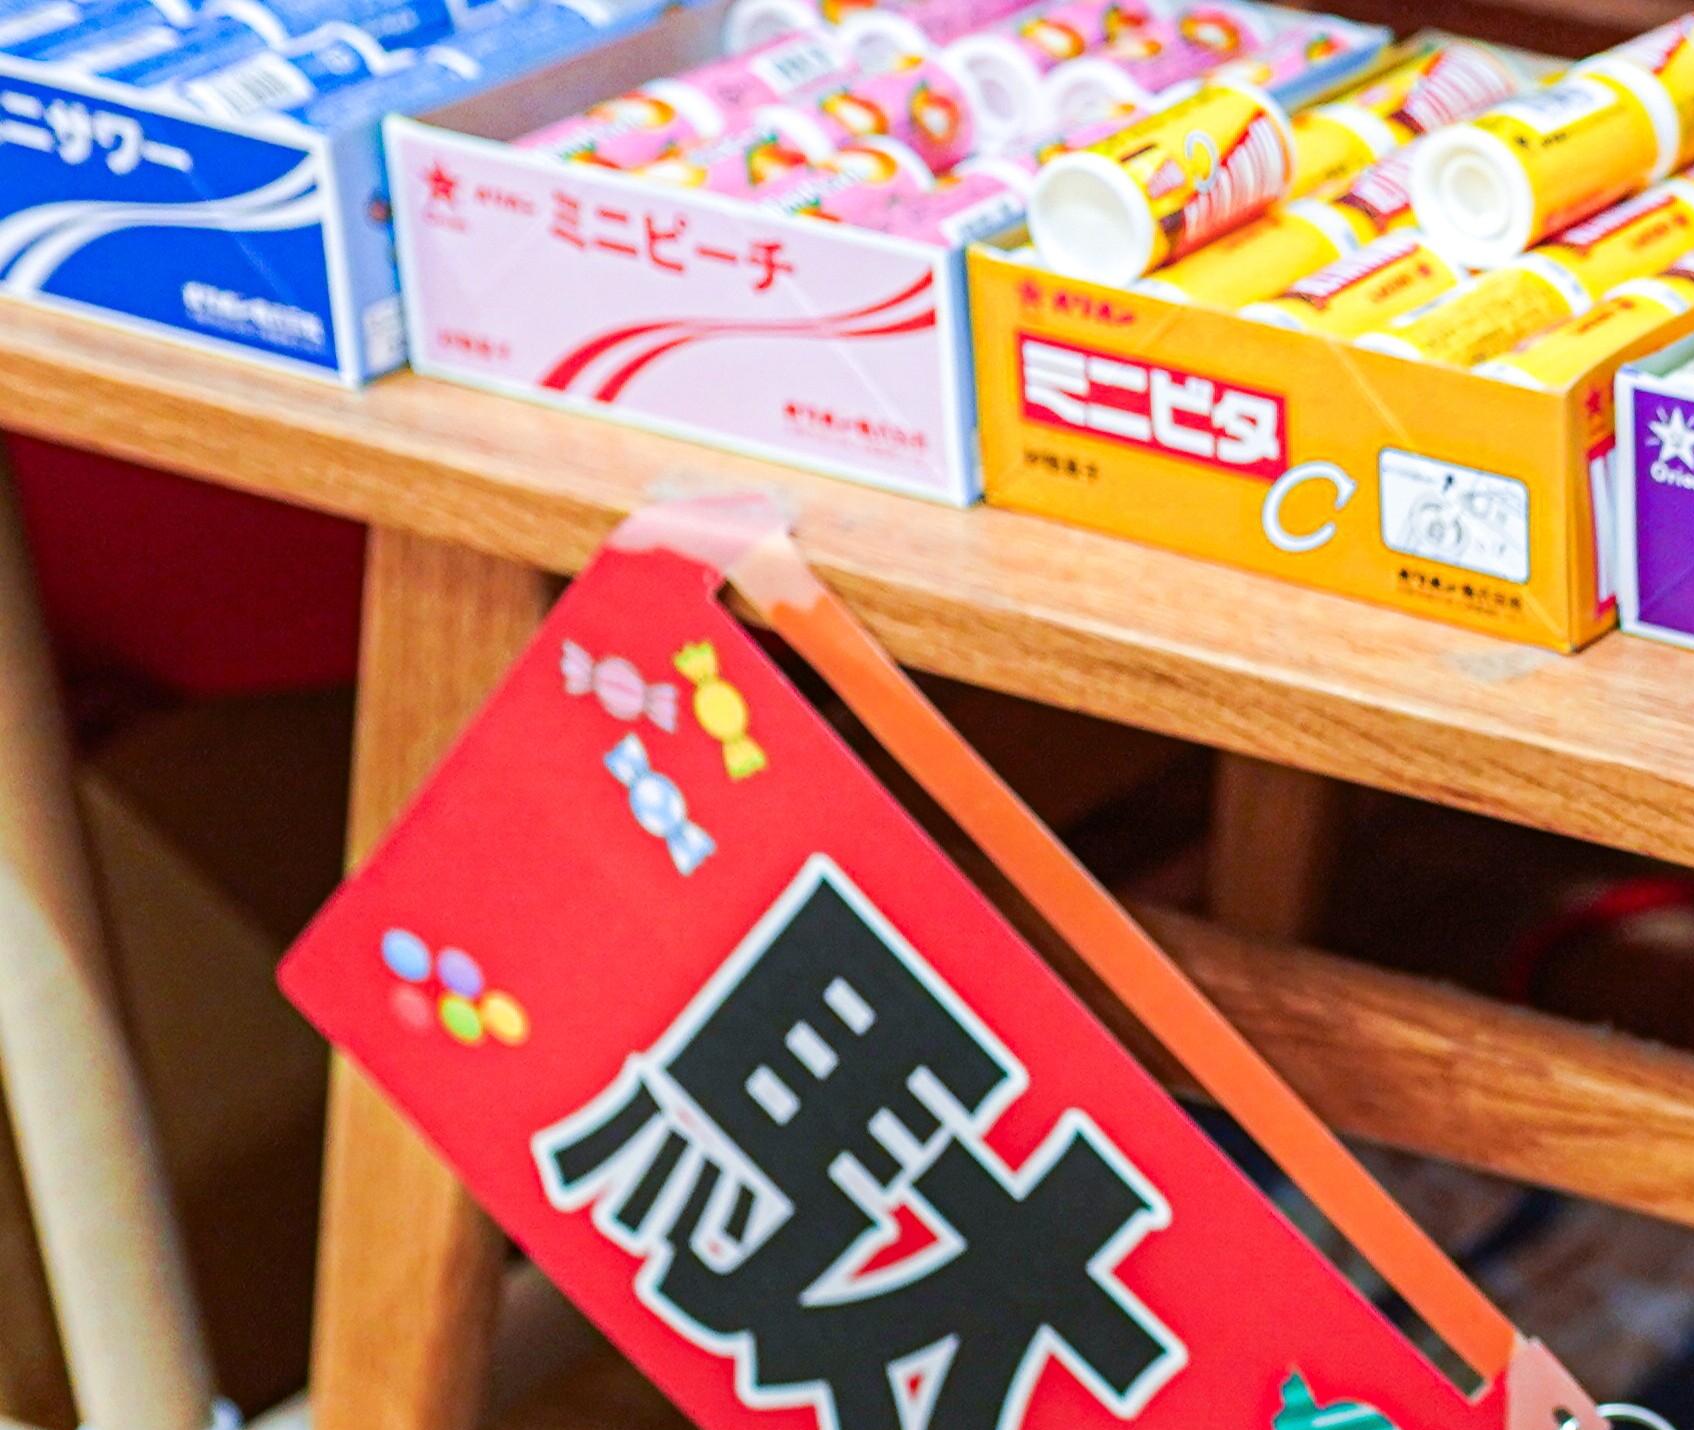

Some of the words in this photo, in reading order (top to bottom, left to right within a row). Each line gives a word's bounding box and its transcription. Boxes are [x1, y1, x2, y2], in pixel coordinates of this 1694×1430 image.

[550, 192, 794, 293] ミニピーチ
[1021, 338, 1282, 464] ミニビタ
[1261, 459, 1357, 553] C
